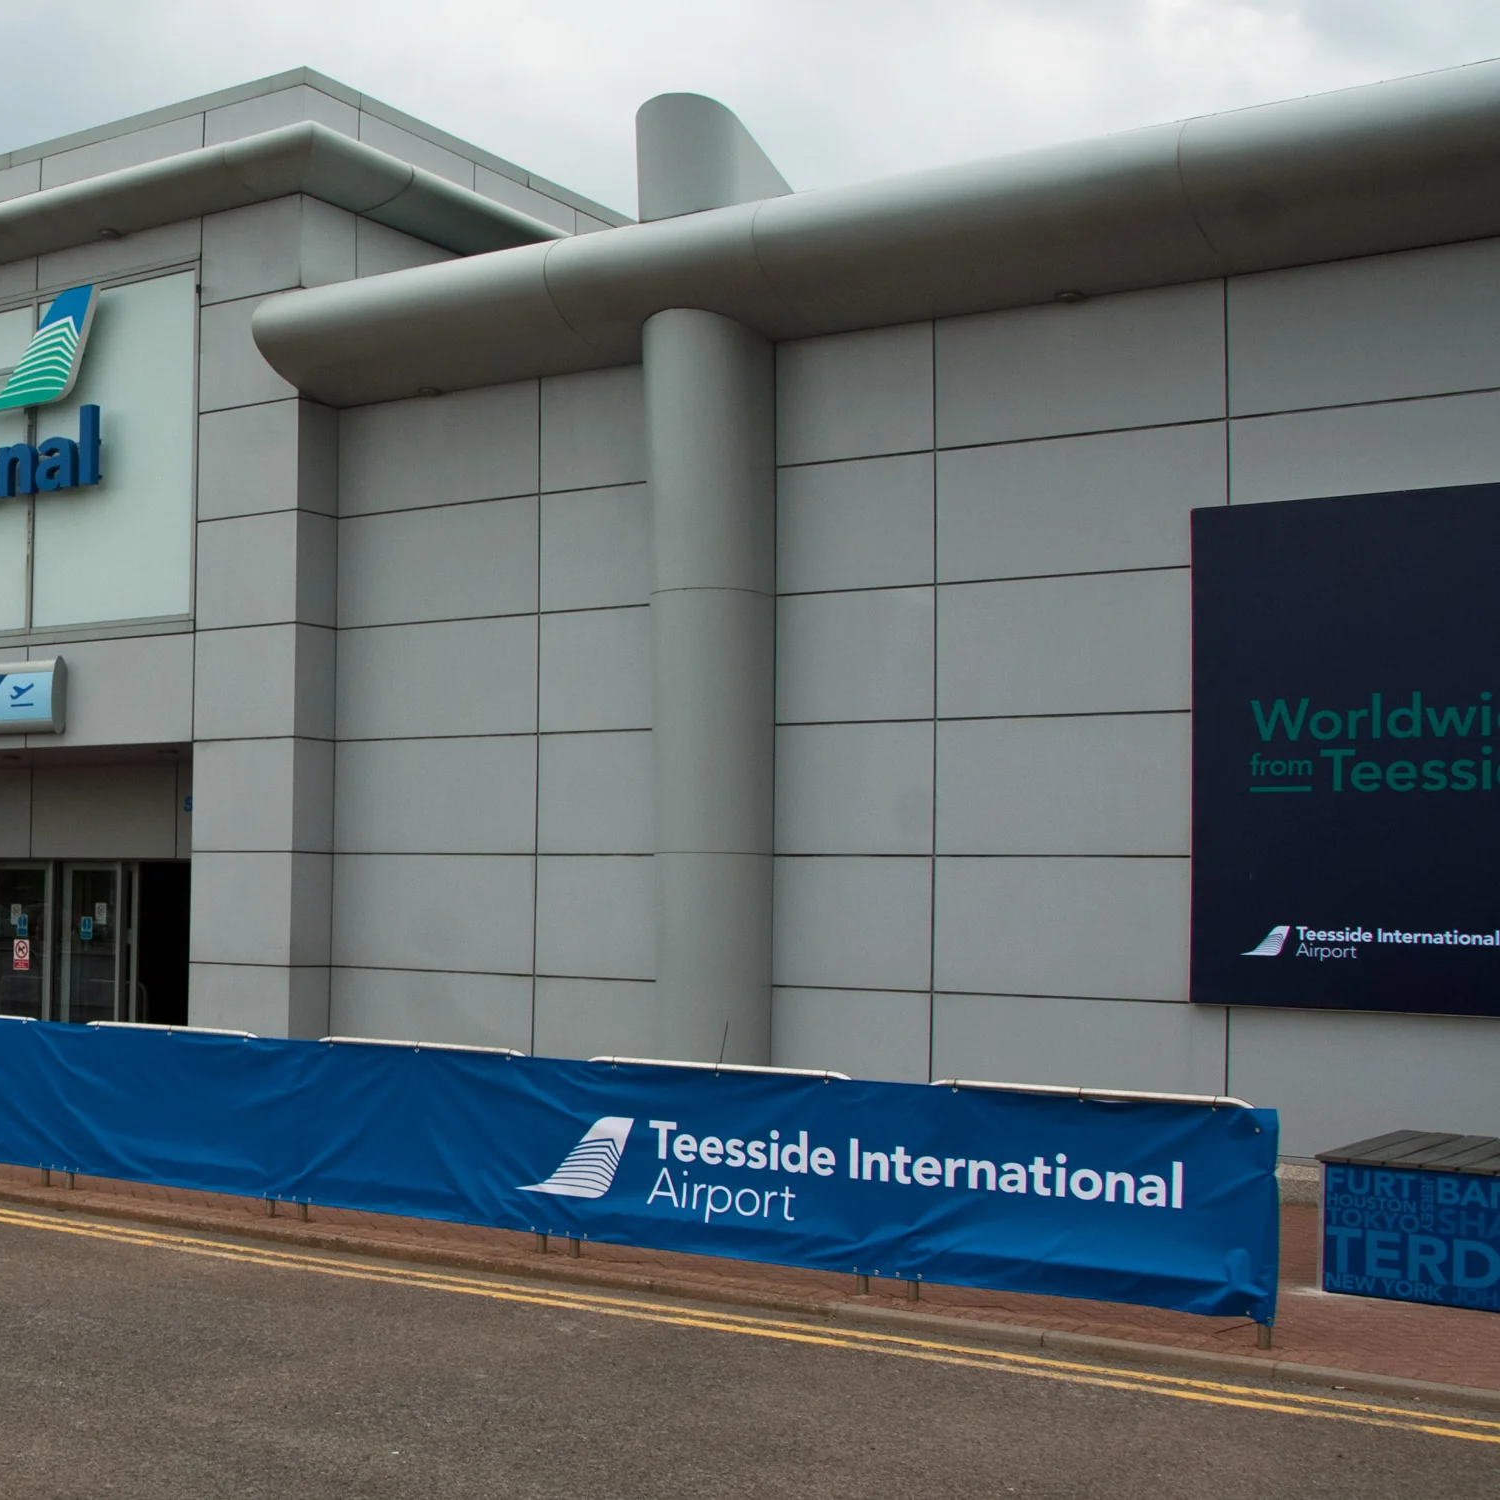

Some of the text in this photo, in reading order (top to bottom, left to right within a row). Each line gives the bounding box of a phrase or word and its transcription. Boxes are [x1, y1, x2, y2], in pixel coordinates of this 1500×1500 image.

[1250, 691, 1500, 742] Worldwi
[1250, 753, 1312, 776] from
[1296, 926, 1500, 946] Teesside International
[1296, 943, 1357, 961] Airport
[649, 1119, 1185, 1210] Teesside International
[646, 1167, 796, 1224] Airport
[1326, 1167, 1417, 1199] FURT
[1326, 1192, 1417, 1213] HOUSTON
[1420, 1174, 1435, 1233] JERSEY
[1326, 1206, 1421, 1234] TOKYO
[1325, 1271, 1444, 1301] NEW YORK
